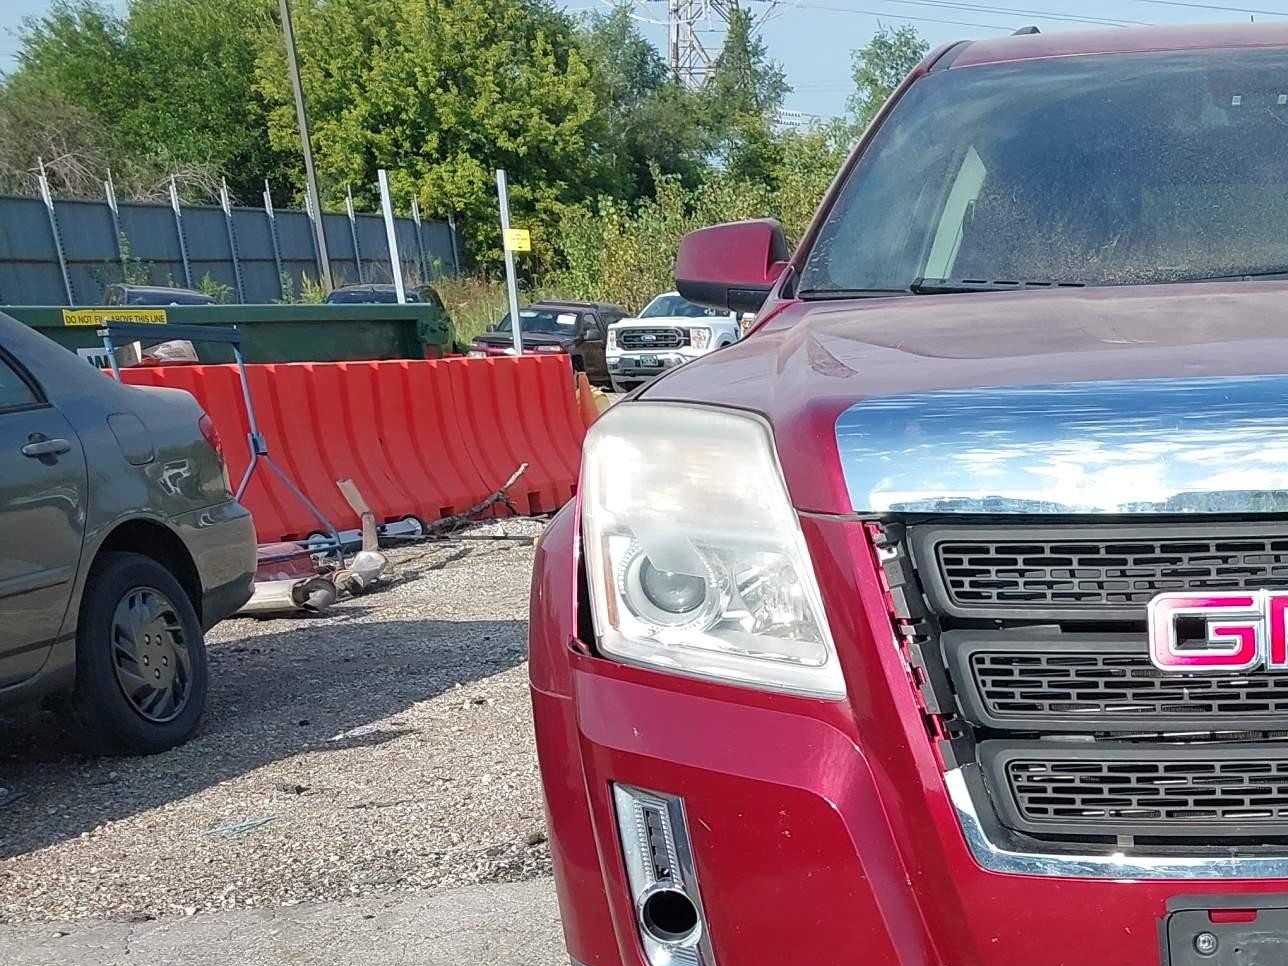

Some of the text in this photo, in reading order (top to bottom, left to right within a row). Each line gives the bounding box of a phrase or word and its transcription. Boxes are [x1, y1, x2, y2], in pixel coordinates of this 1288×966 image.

[65, 315, 77, 324] DO
[78, 315, 92, 324] NOT
[134, 314, 149, 323] THIS
[150, 314, 165, 323] LINE
